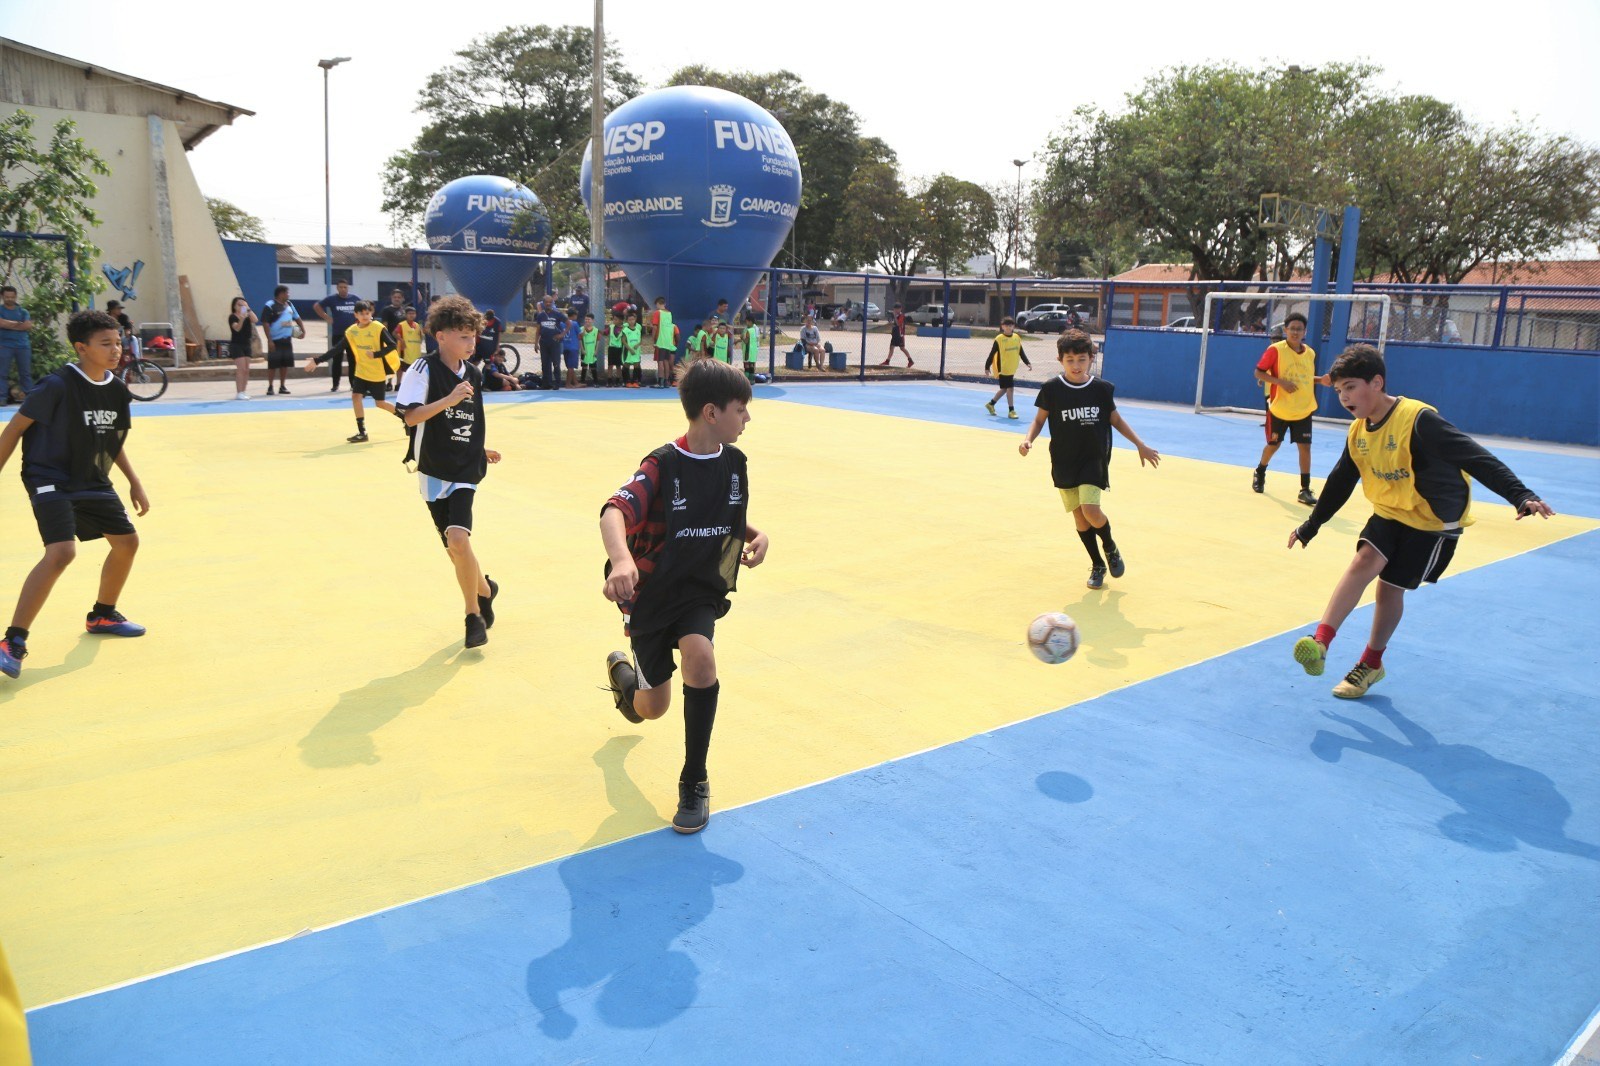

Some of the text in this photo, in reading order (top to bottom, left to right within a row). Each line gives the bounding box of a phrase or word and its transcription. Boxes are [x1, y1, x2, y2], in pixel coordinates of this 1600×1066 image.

[604, 121, 665, 156] NESP
[714, 120, 796, 159] FUNES
[626, 152, 664, 164] Municipal
[604, 165, 632, 176] Esportes
[763, 164, 771, 173] de
[771, 165, 793, 177] Esportes
[467, 194, 530, 214] FUNES
[604, 197, 683, 216] MPO GRANDE
[740, 198, 780, 214] CAMPO
[780, 203, 798, 220] GRAN
[481, 236, 512, 247] CAMPO
[1061, 406, 1100, 421] FUNESP
